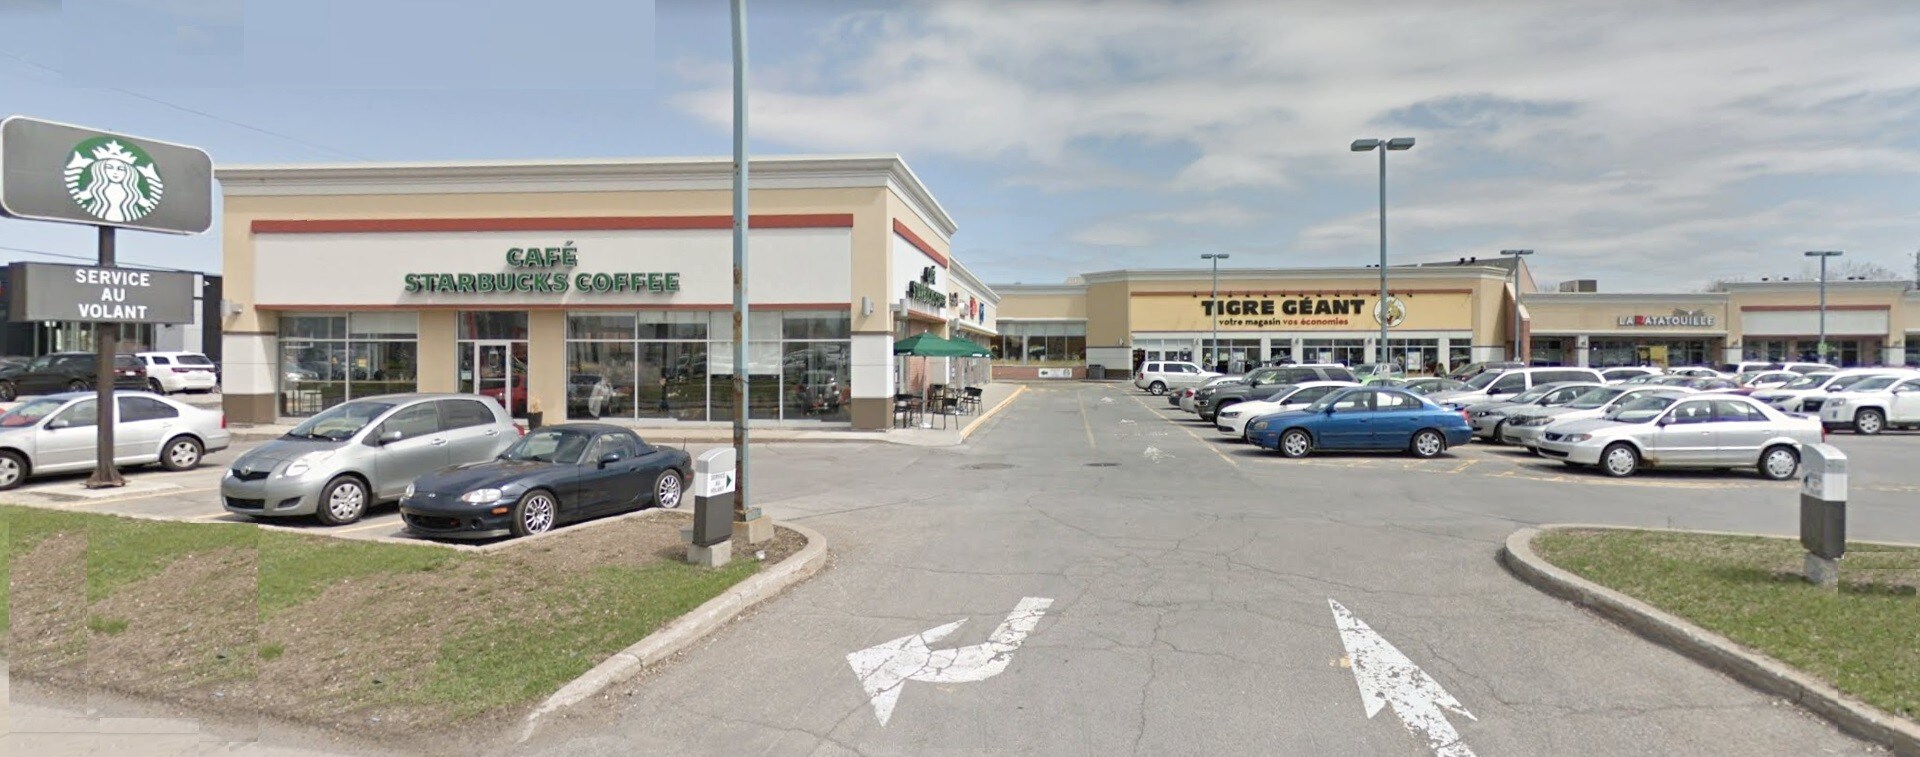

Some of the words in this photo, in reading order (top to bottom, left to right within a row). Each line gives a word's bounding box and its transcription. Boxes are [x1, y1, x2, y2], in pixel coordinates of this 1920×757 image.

[506, 240, 578, 267] CAFÉ
[75, 269, 150, 286] SERVICE
[404, 272, 569, 293] STARBUCKS
[574, 272, 681, 293] COFFEE
[101, 288, 126, 302] AU
[78, 303, 147, 319] VOLANT
[1201, 300, 1275, 316] TIGRE
[1282, 297, 1365, 315] GÉANT
[1219, 318, 1243, 326] votre
[1245, 318, 1281, 328] magasin
[1300, 317, 1349, 326] économies
[1617, 315, 1634, 326] LA
